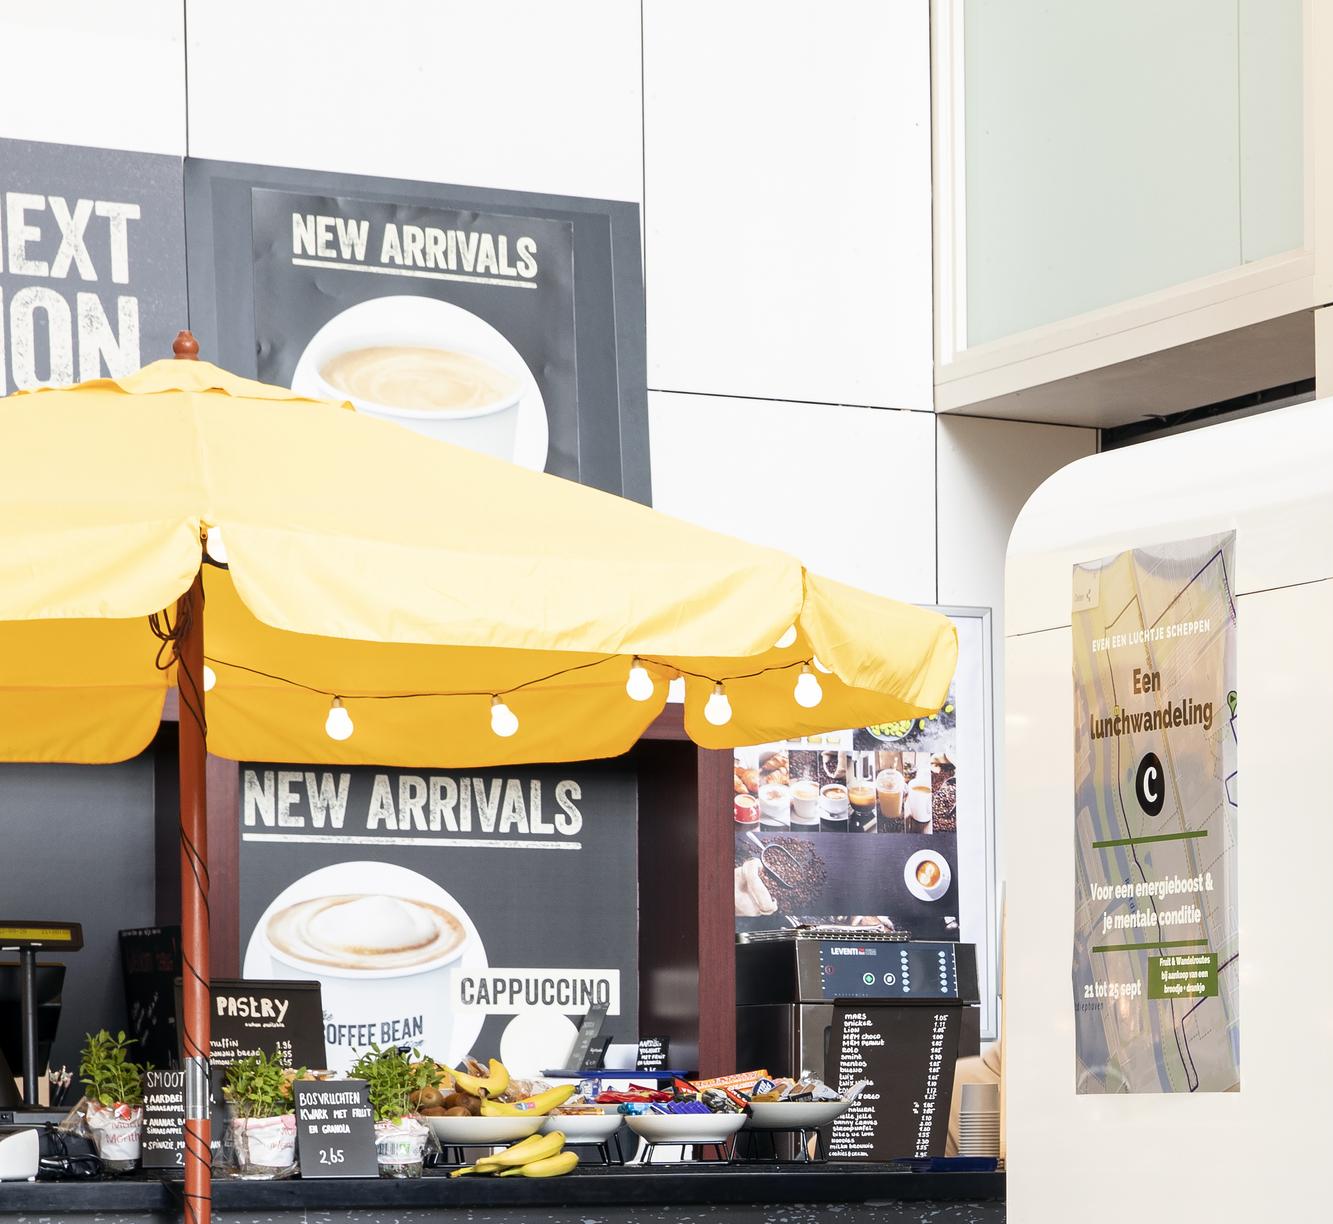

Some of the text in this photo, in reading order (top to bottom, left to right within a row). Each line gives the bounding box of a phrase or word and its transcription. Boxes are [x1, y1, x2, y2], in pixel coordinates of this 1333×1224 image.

[0, 191, 141, 284] EXT
[292, 213, 538, 278] NEW ARRIVALS
[1092, 619, 1210, 653] EVEN EEN LUCHTJE SCHEPPEN
[1133, 668, 1160, 695] Een
[1090, 698, 1213, 740] lunchwandeling
[243, 769, 584, 836] NEW ARRIVALS
[1090, 872, 1214, 901] Voor een energieboost &
[1102, 904, 1201, 935] je mentale conditie
[1159, 957, 1171, 966] Fruit
[460, 977, 610, 1006] CAPPUCCINO
[1084, 979, 1142, 1000] 21 tot 25 sept
[322, 1015, 423, 1047] OFFEE BEAN
[147, 1072, 186, 1088] SMOOT
[299, 1092, 360, 1106] BOSVRUCHTEN
[300, 1105, 371, 1120] KWARK MET FRUIT
[308, 1124, 351, 1134] EN GRANOLA
